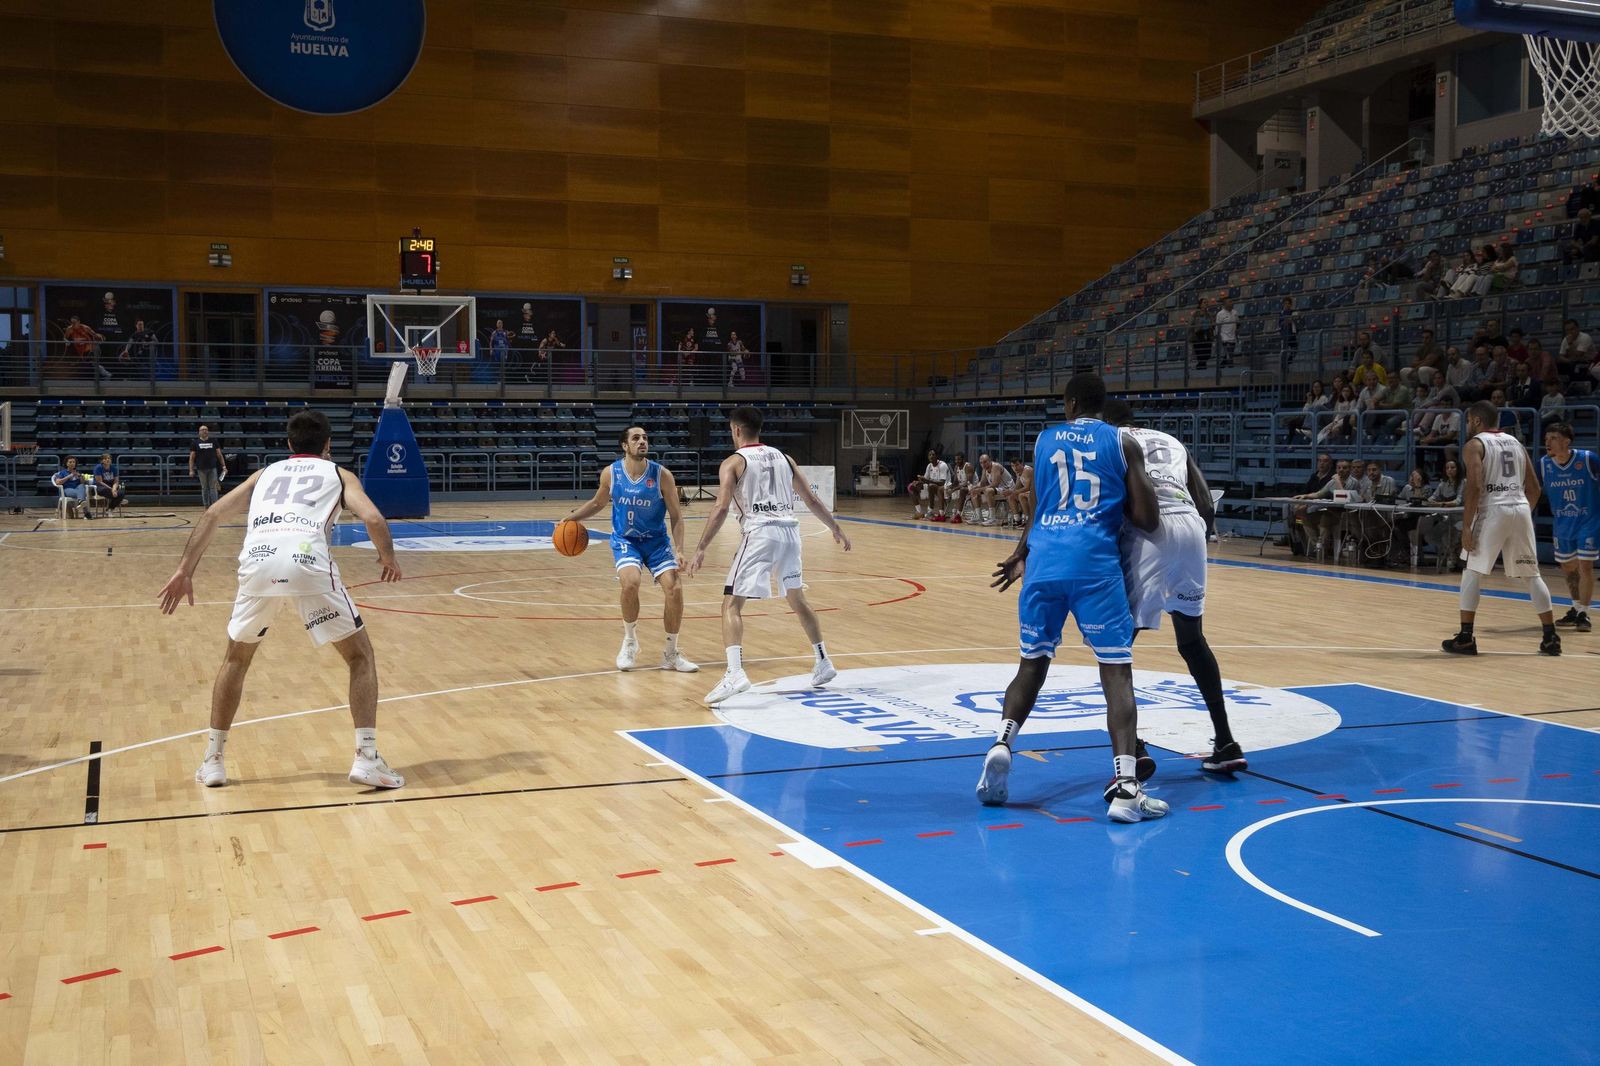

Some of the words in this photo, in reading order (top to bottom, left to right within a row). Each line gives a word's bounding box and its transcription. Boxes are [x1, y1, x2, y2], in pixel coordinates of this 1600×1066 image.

[290, 32, 339, 43] Ayuntamiento
[290, 42, 349, 57] HUELVA
[410, 239, 433, 251] 2:48
[421, 254, 431, 273] 7
[317, 358, 341, 366] COPA
[1055, 430, 1095, 444] MOHA
[1502, 451, 1516, 477] 6
[1049, 448, 1101, 511] 15
[262, 474, 325, 508] 42
[627, 510, 635, 526] 9
[291, 553, 318, 562] ALTUNA
[776, 690, 956, 743] HUELVA
